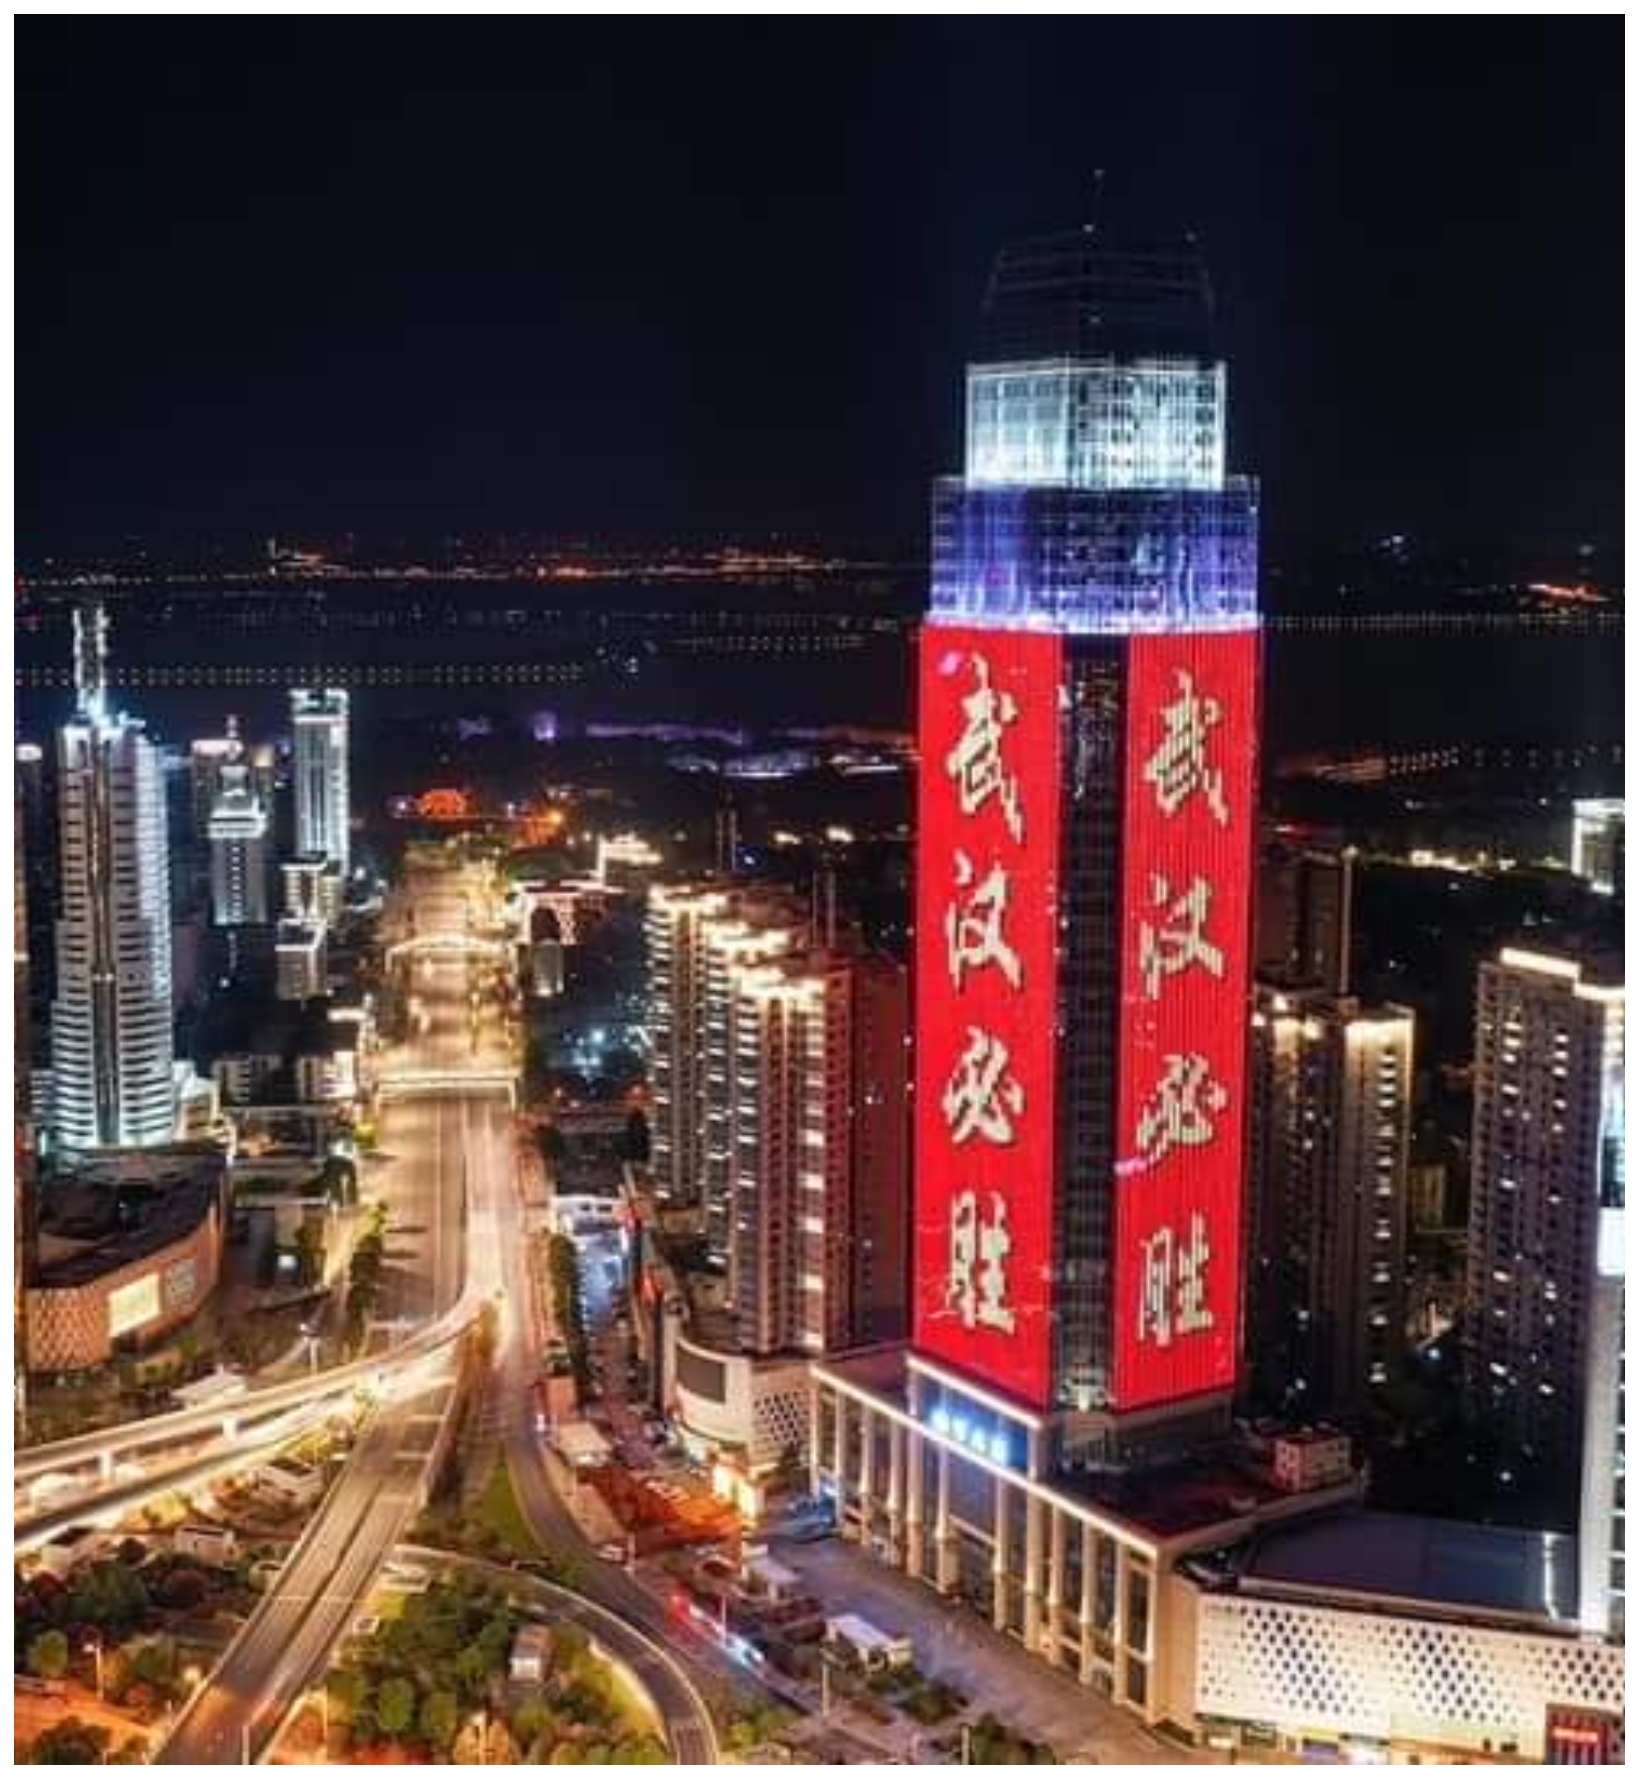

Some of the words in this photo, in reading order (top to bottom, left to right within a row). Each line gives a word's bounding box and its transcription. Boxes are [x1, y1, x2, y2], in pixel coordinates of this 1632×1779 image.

[943, 653, 1024, 1334] 武汉必胜
[1136, 669, 1230, 1347] 武汉必胜
